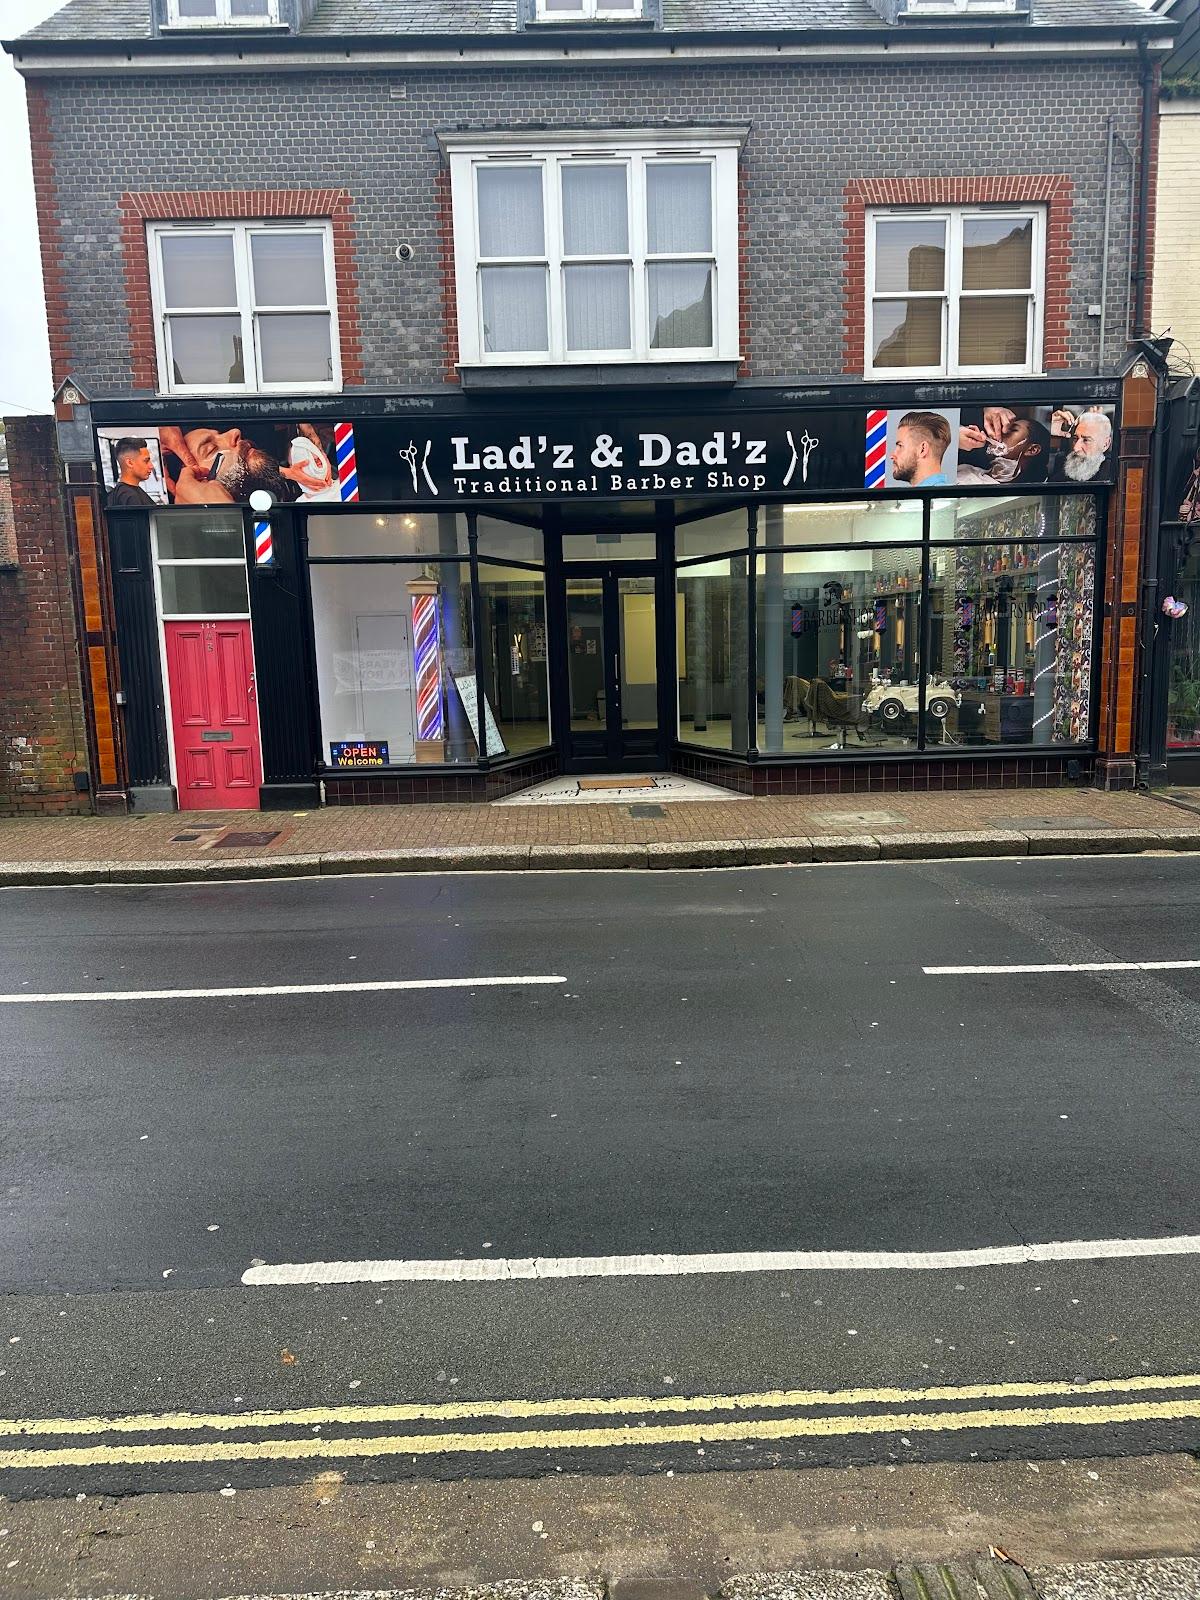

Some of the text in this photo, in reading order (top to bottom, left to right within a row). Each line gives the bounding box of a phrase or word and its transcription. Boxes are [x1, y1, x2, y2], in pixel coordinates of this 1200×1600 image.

[451, 431, 767, 470] Lad’z & Dad’z
[453, 471, 766, 493] Traditional Barber Shop
[201, 622, 216, 630] 114
[343, 747, 377, 757] OPEN
[337, 757, 383, 766] Welcome
